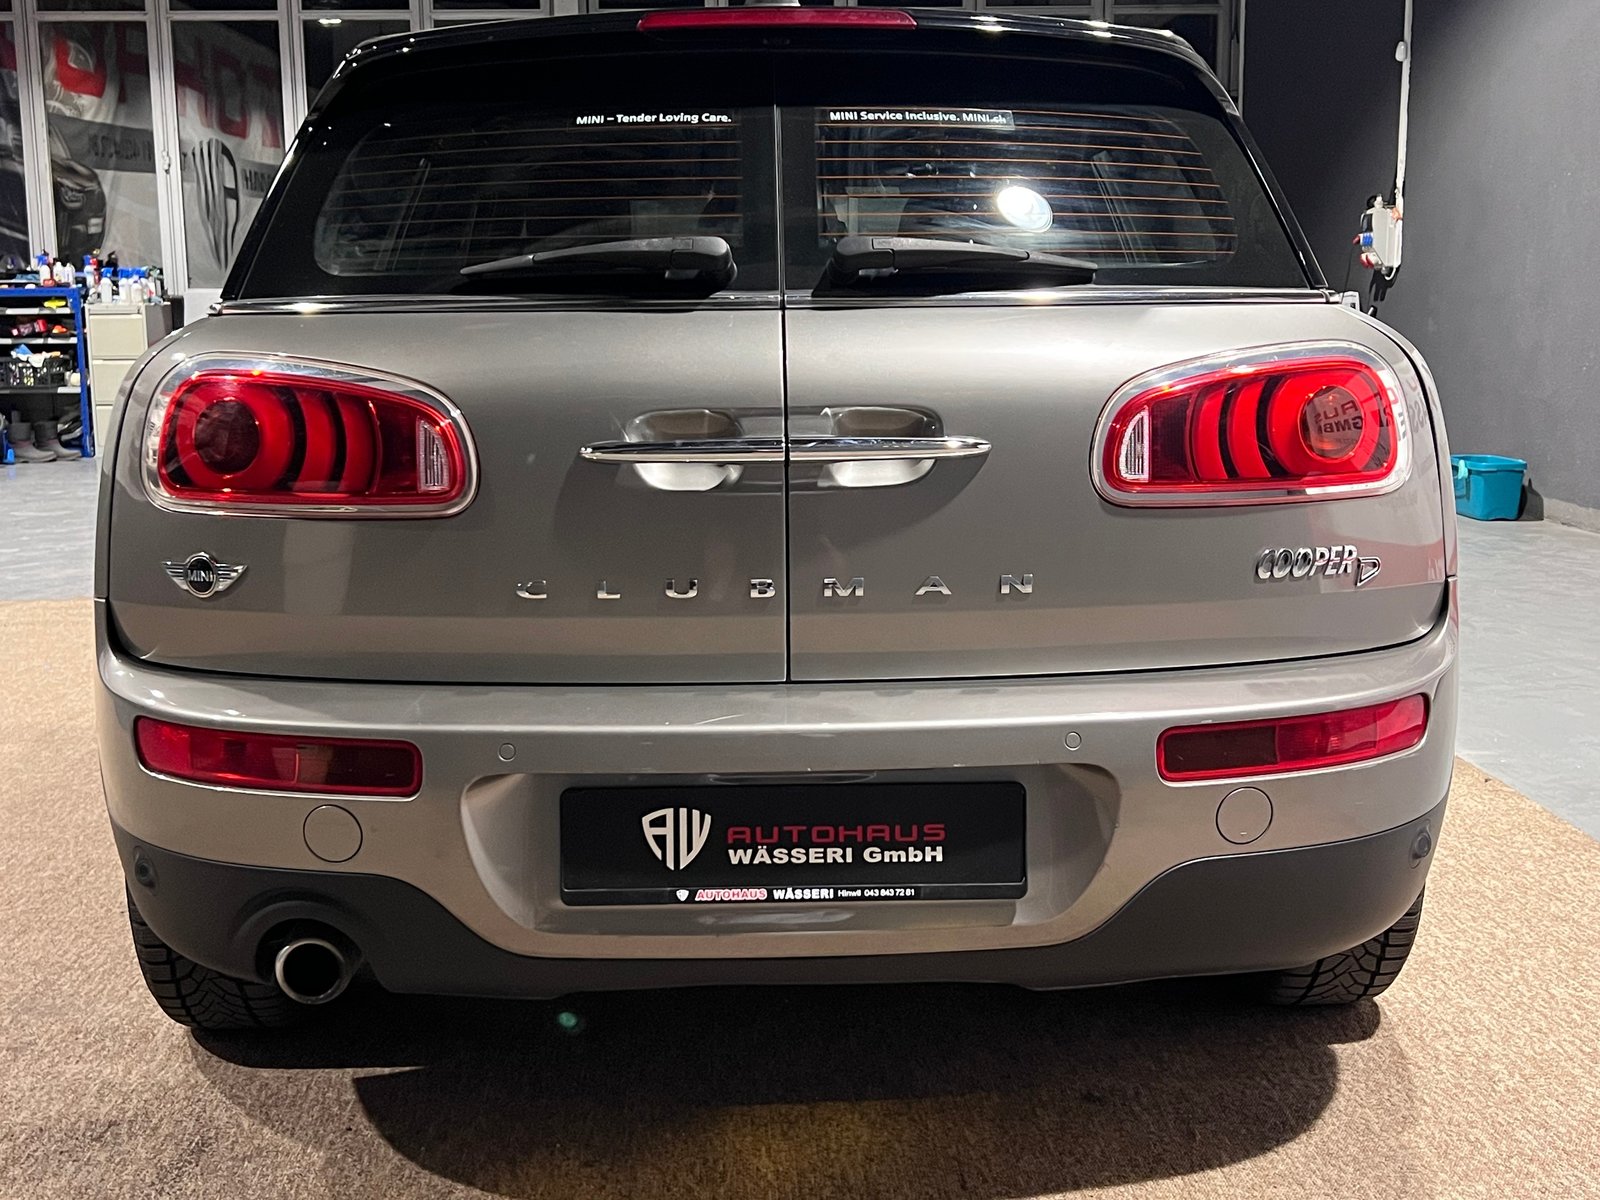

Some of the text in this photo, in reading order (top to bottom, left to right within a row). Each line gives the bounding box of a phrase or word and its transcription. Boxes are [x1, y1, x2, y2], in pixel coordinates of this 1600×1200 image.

[576, 115, 604, 125] MINI
[616, 113, 657, 123] Tender
[659, 112, 699, 124] Loving
[701, 112, 732, 122] Care.
[829, 111, 1007, 124] MINI Service Inclusive. MINI.ch
[1256, 544, 1382, 587] COOPER D
[187, 569, 214, 582] MINI
[515, 573, 1034, 600] CLUBMAN
[641, 807, 712, 871] AW
[727, 823, 946, 844] AUTOHAUS
[728, 846, 944, 865] WÄSSERI GmbH
[695, 888, 768, 901] AUTOHAUS
[773, 887, 834, 900] WÄSSERI
[863, 888, 880, 897] 043
[880, 888, 895, 897] 843
[895, 888, 905, 896] 72
